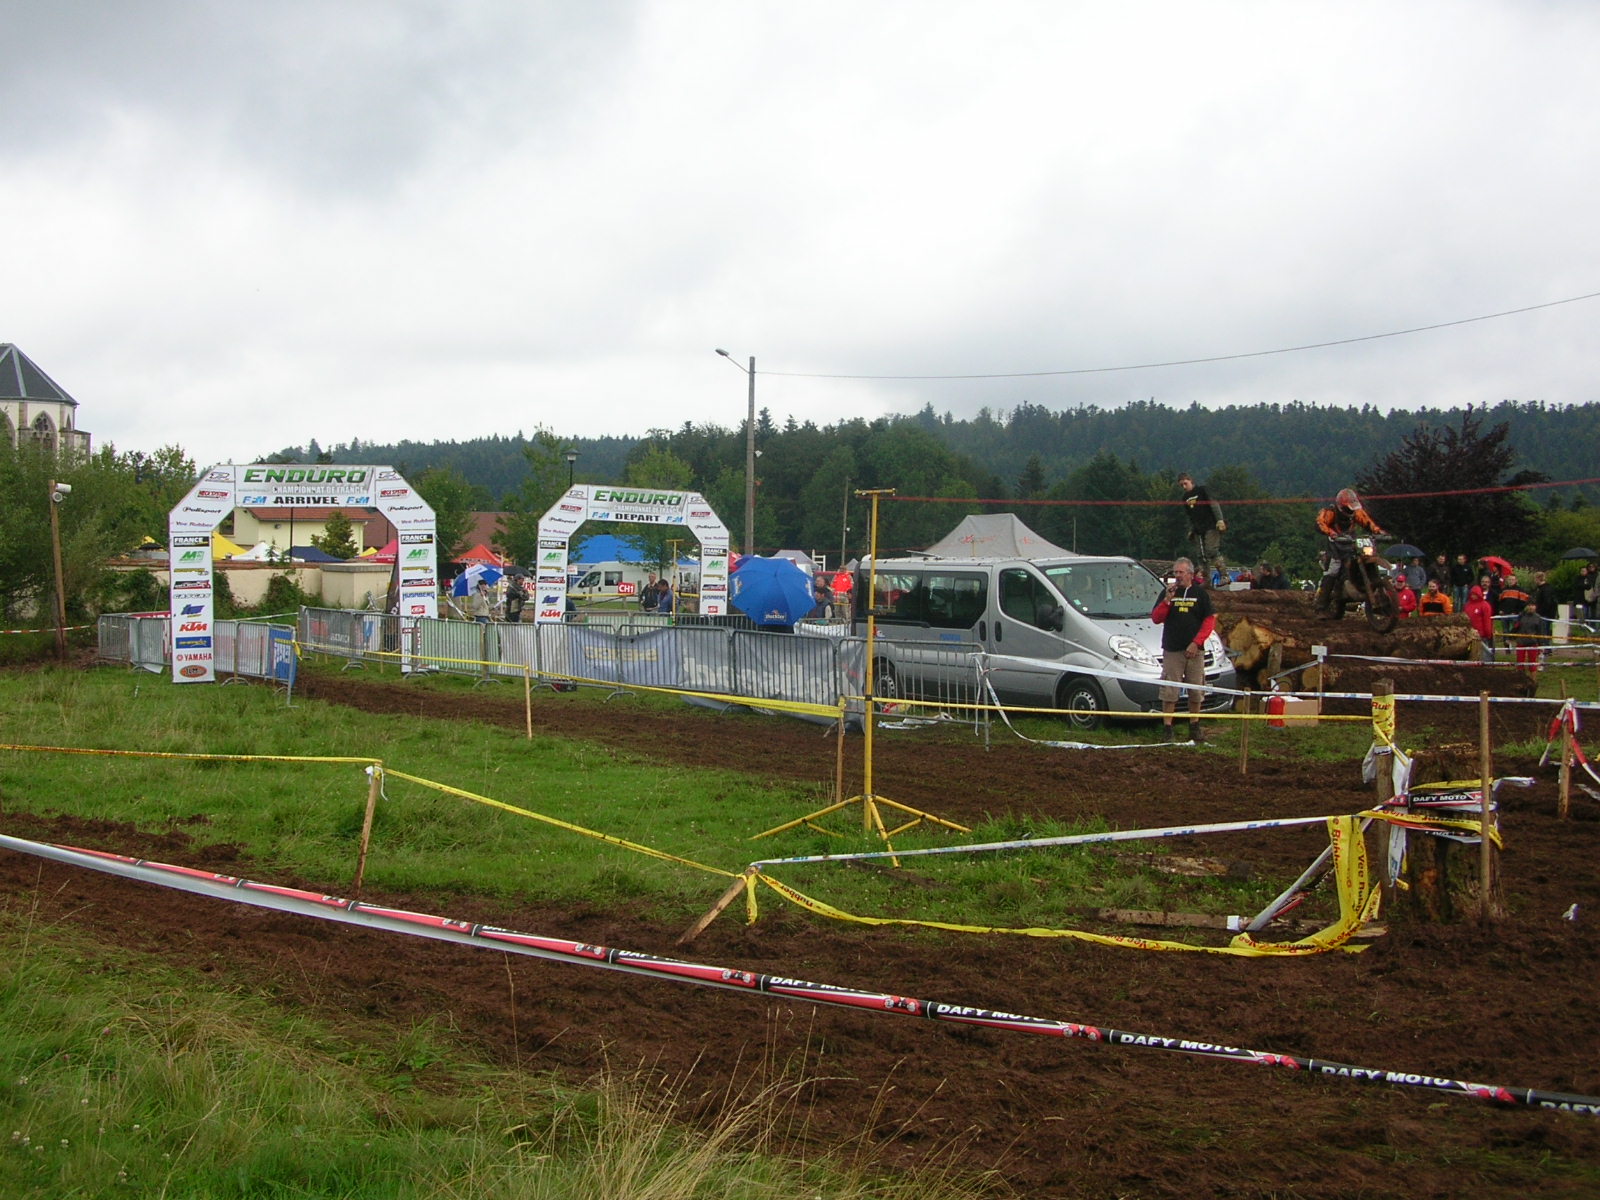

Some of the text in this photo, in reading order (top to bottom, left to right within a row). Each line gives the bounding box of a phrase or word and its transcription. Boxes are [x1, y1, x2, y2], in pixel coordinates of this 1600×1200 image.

[243, 469, 367, 483] ENDURO
[273, 496, 340, 504] ARRIVEE
[594, 490, 682, 506] ENDURO
[615, 513, 660, 522] DEPART
[619, 584, 634, 593] CH1
[540, 609, 562, 618] KTM
[179, 621, 208, 631] KTM
[184, 652, 212, 661] YAMAHA
[936, 1004, 988, 1016] DAFY
[1120, 1034, 1175, 1047] DAFY
[1385, 1072, 1450, 1086] MOTO
